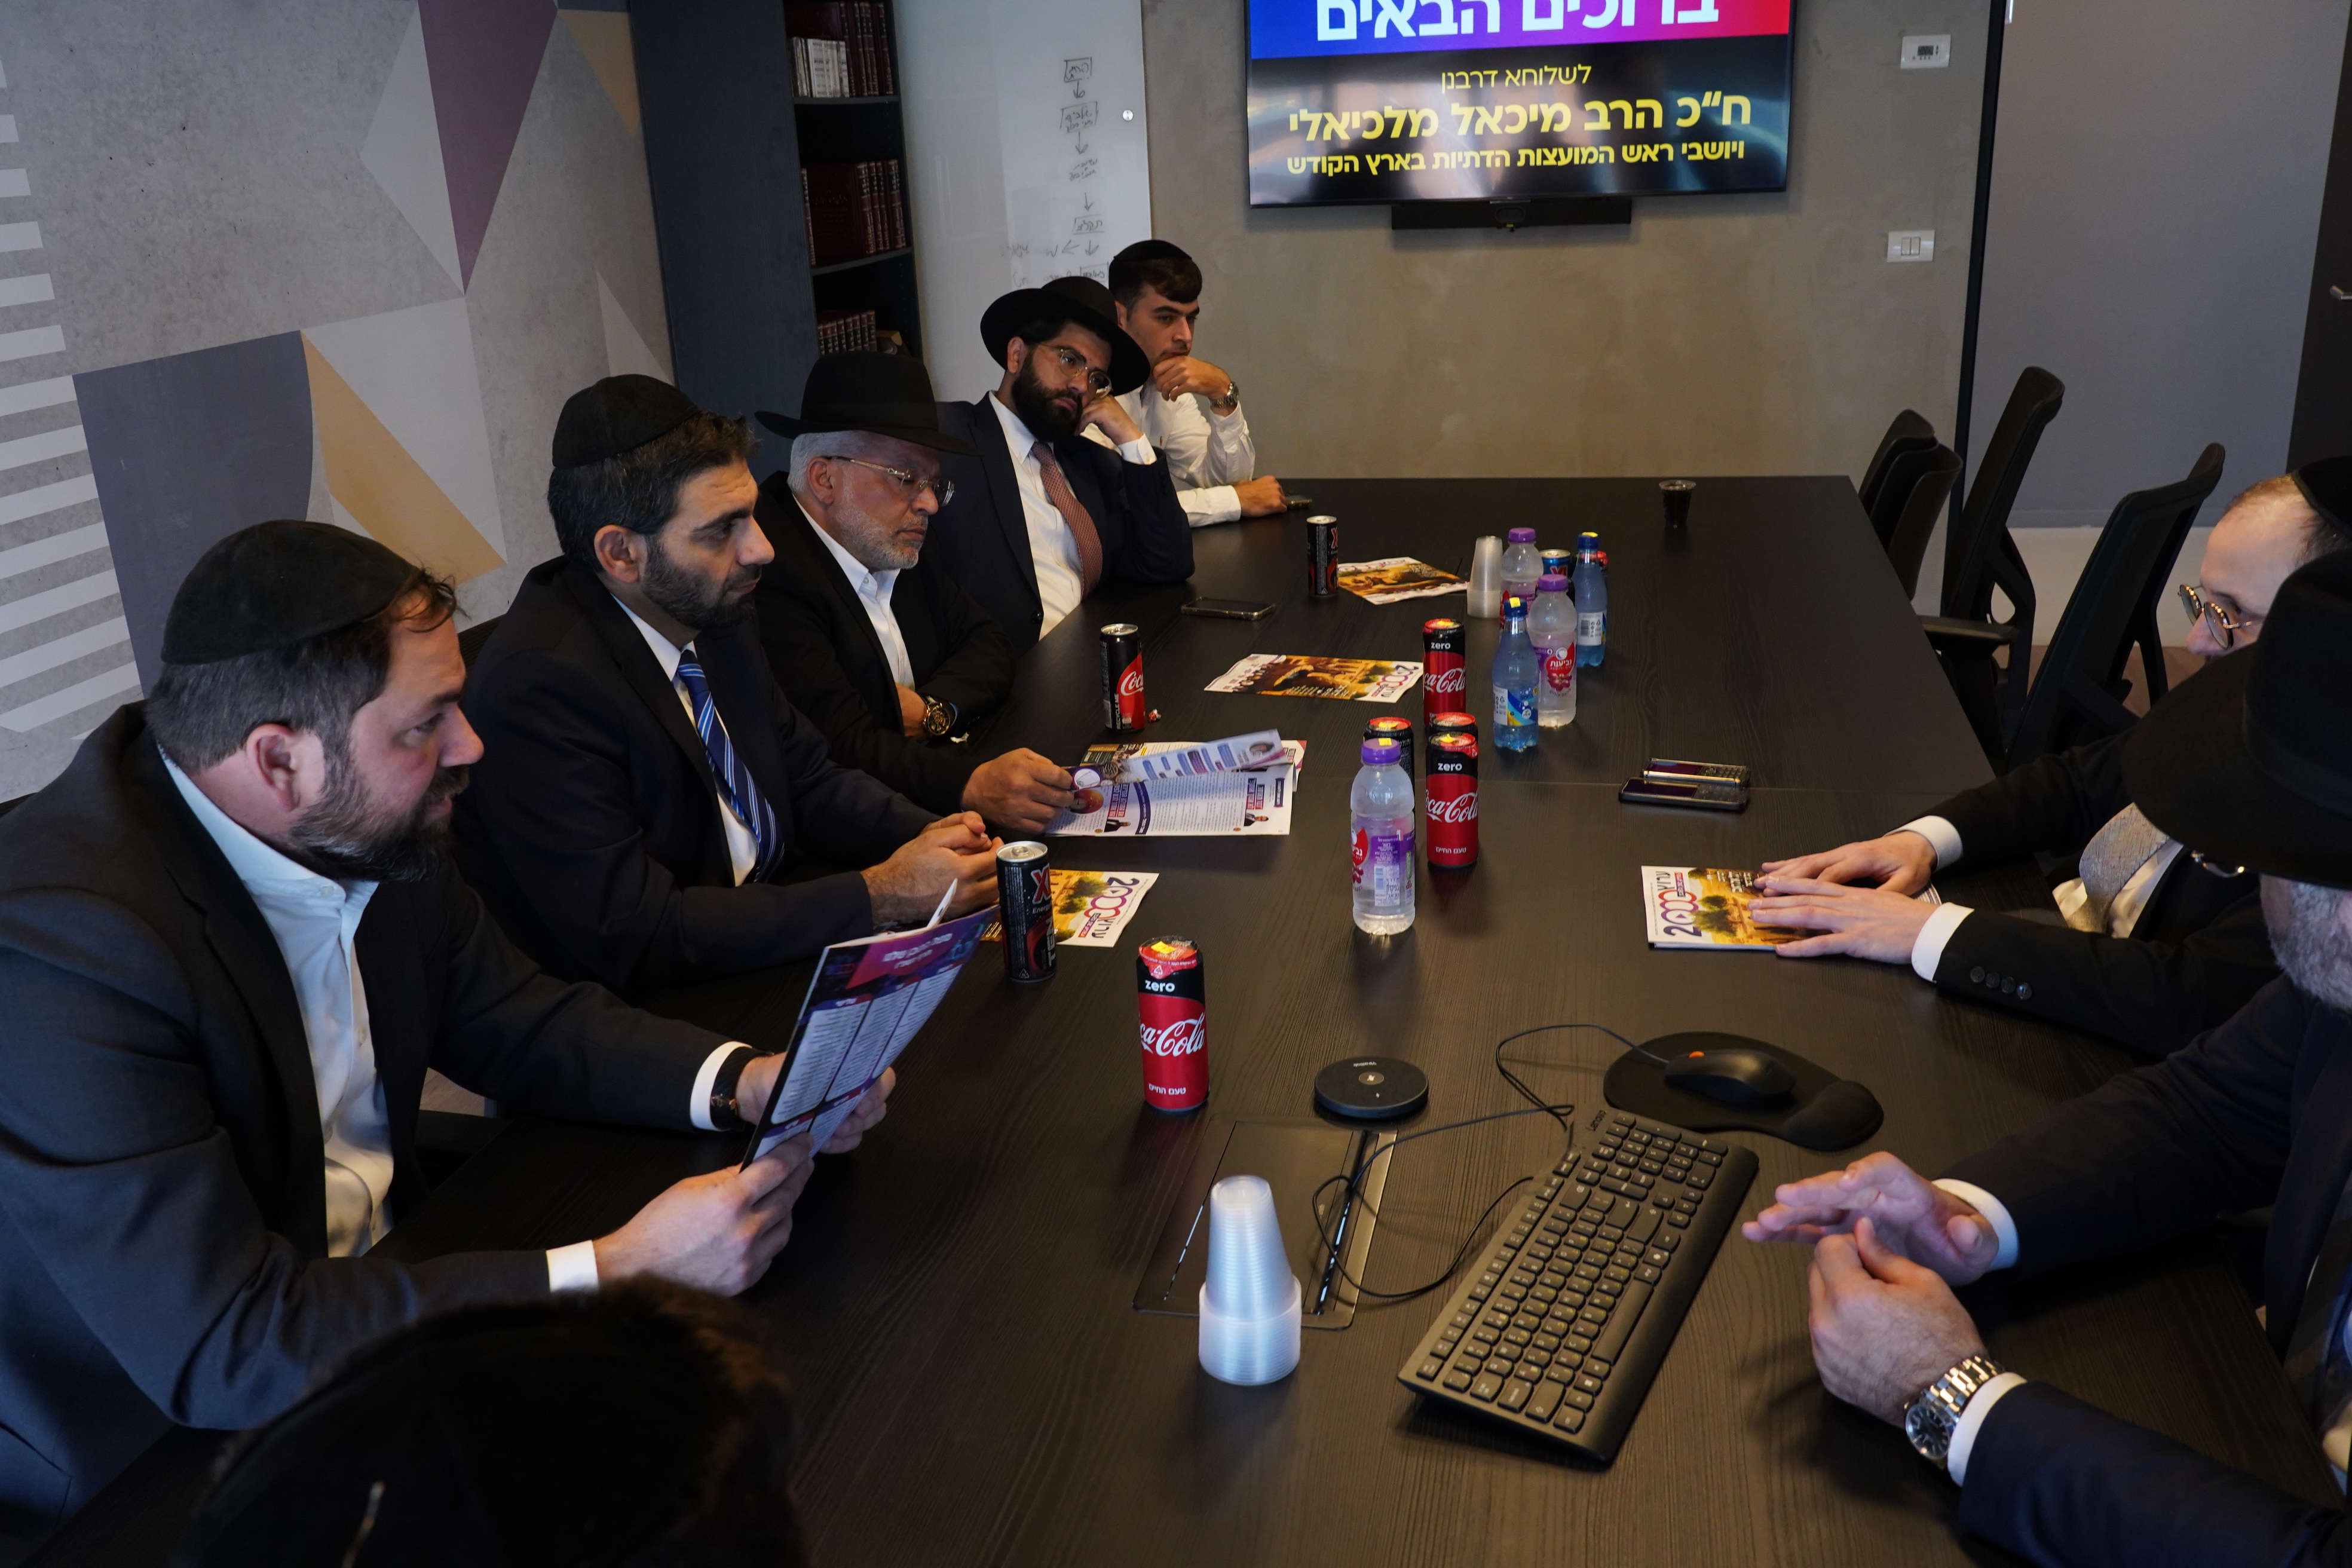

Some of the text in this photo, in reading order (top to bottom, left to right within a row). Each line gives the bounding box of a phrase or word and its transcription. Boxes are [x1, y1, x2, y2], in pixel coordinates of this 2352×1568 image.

[1441, 63, 1592, 94] לשלוחא דרבנן
[1290, 106, 1438, 142] מלכיאלי
[1451, 102, 1572, 136] מיכאל
[1584, 99, 1664, 130] הרב
[1287, 141, 1745, 177] ויושבי ראש המועצות הדתיות בארץ הקודש
[1549, 659, 1572, 667] נביעות
[1437, 762, 1463, 771] zero
[1144, 979, 1175, 993] zero
[1148, 1082, 1186, 1095] טעם החיים
